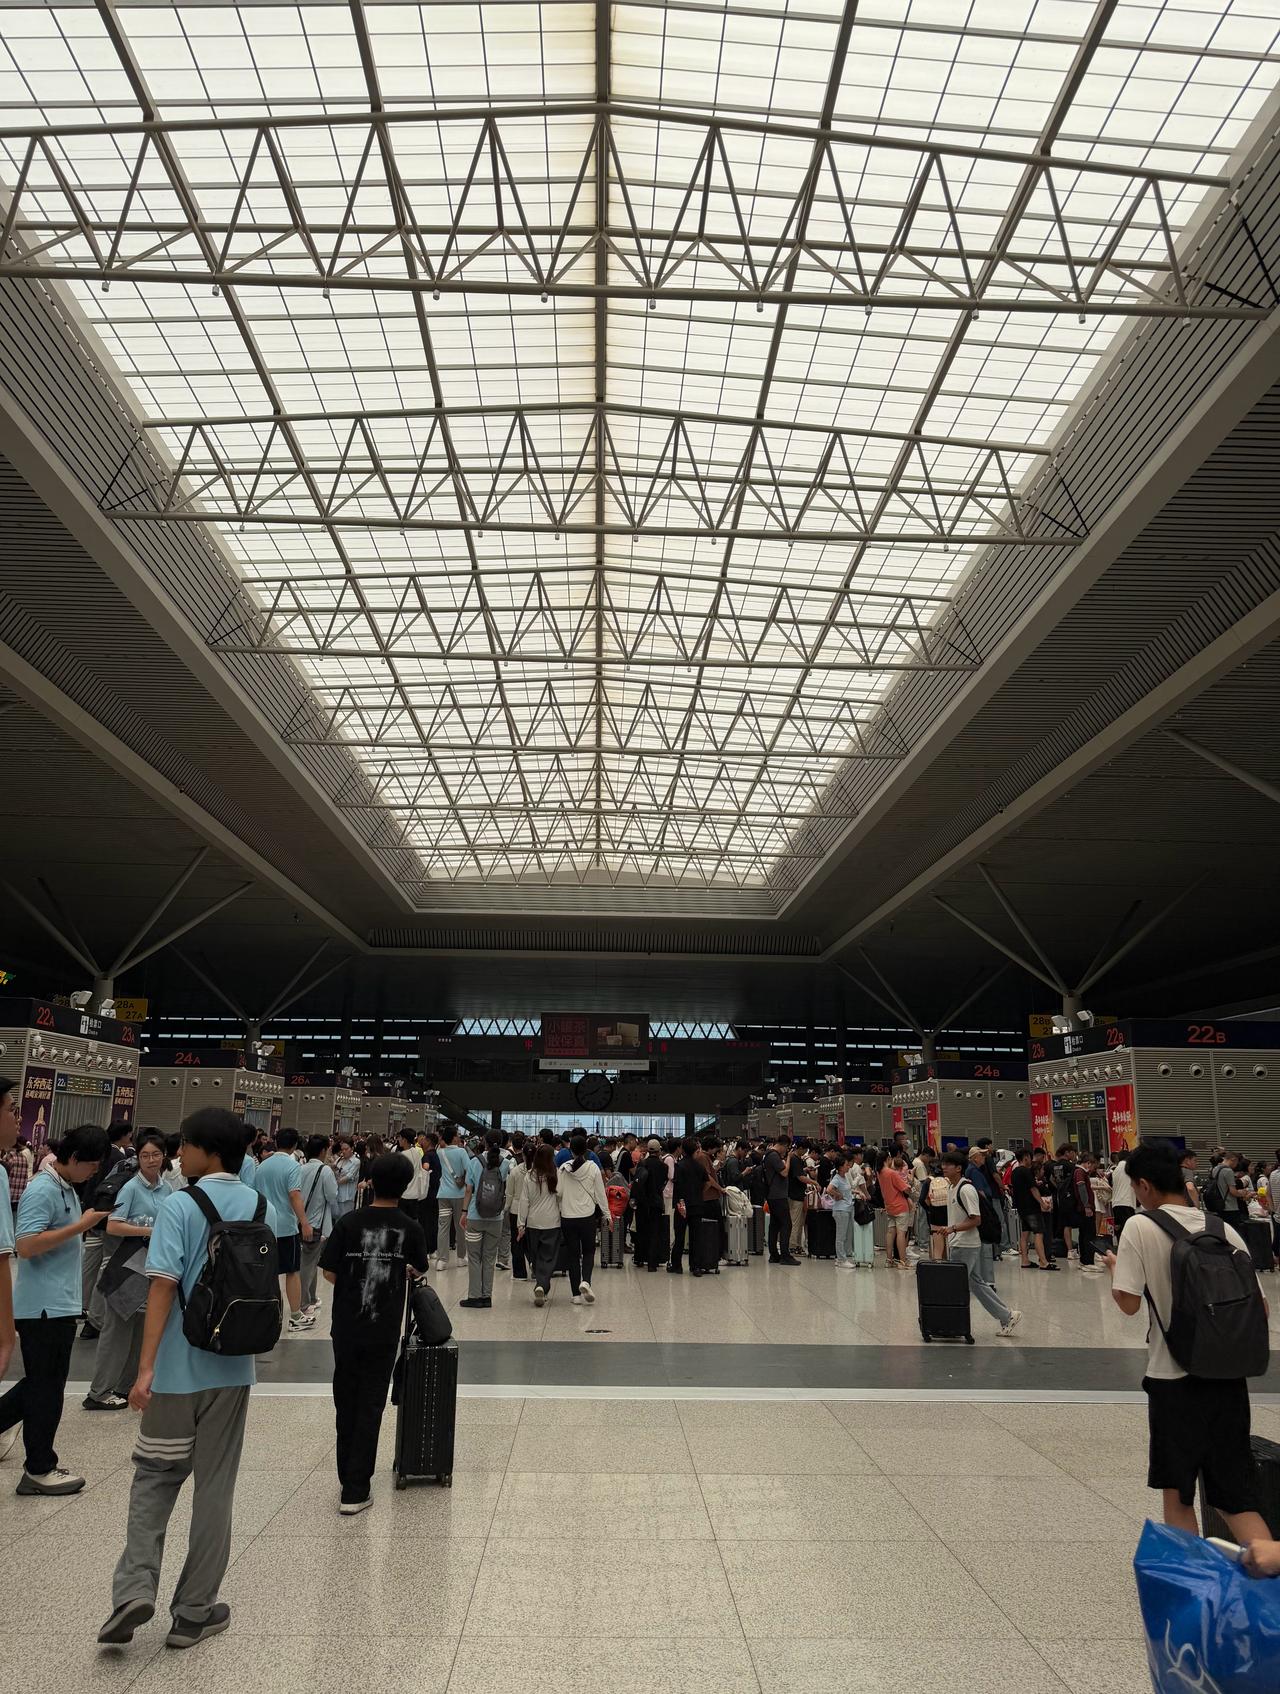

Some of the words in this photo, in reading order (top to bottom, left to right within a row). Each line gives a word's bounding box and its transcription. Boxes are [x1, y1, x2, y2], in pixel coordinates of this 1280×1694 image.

[116, 1000, 134, 1009] 28A
[36, 1007, 55, 1027] 22A
[125, 1011, 143, 1020] 27A
[121, 1026, 135, 1043] 23A
[1106, 1027, 1125, 1046] 22B
[1186, 1025, 1226, 1044] 22B
[174, 1052, 201, 1066] 24A
[974, 1065, 1001, 1077] 24B
[291, 1075, 311, 1086] 26A
